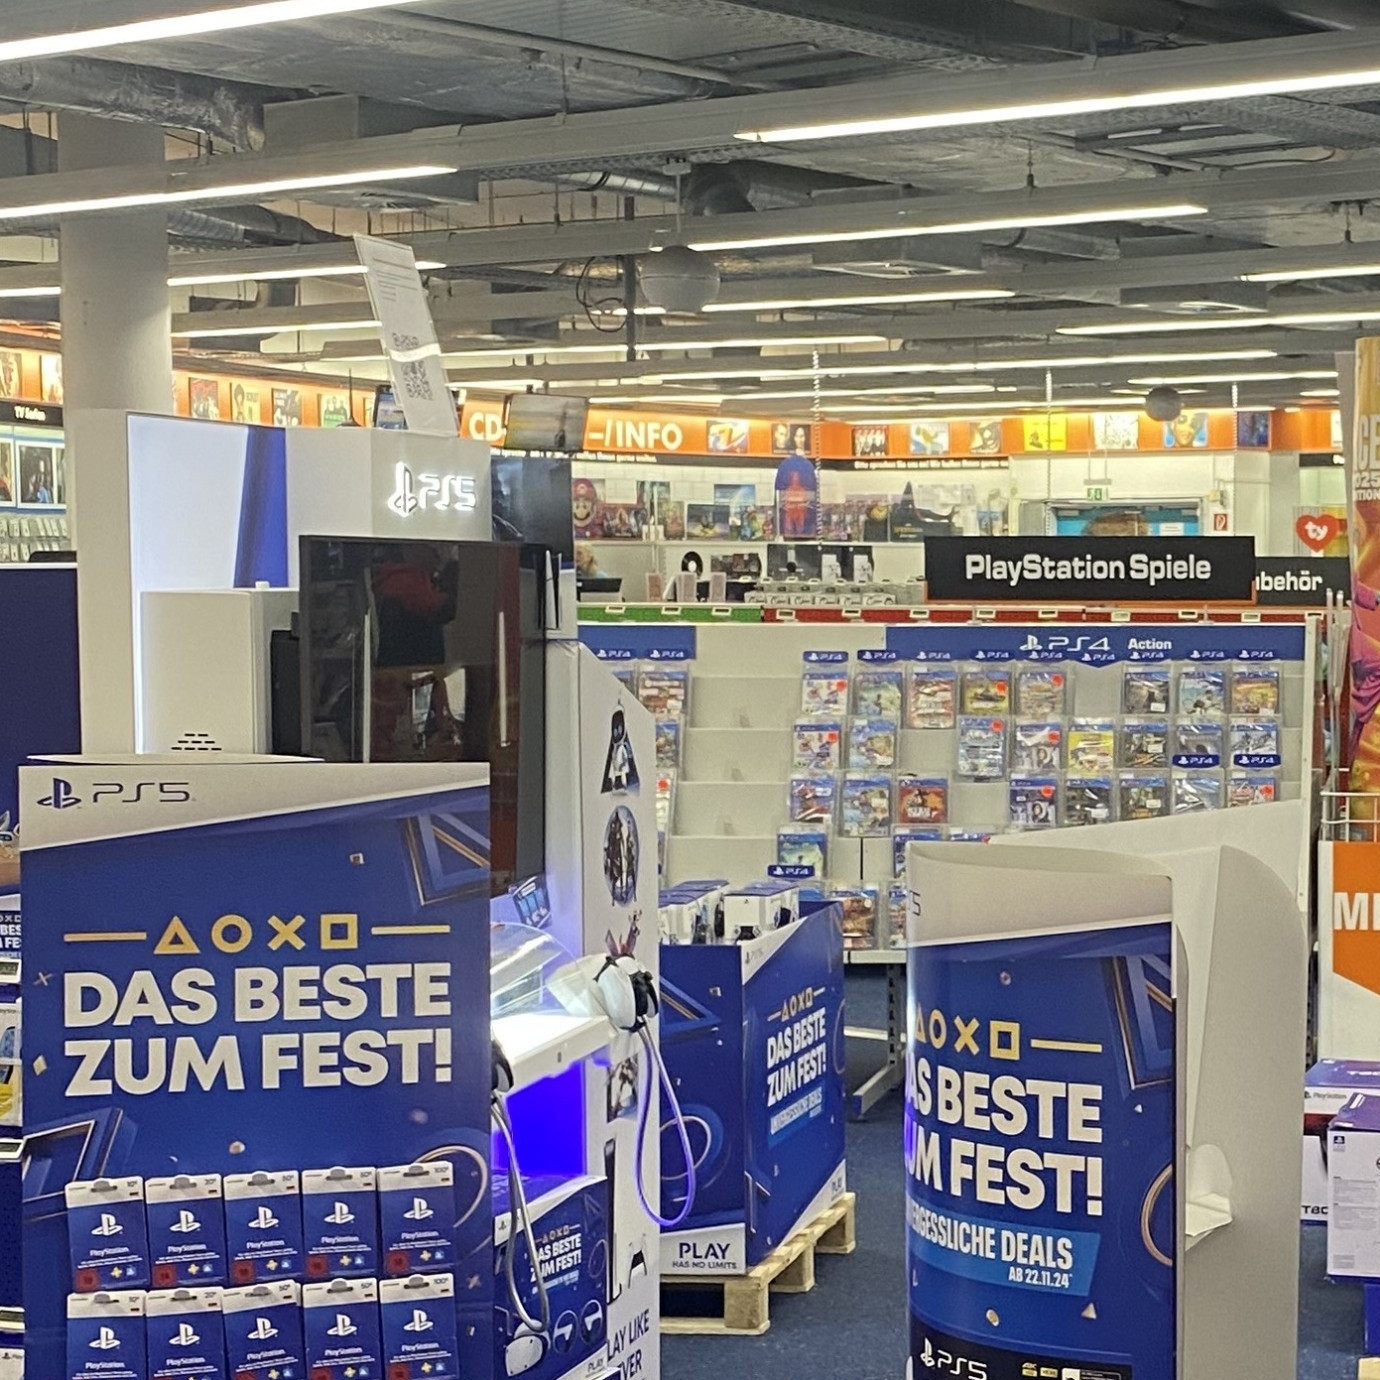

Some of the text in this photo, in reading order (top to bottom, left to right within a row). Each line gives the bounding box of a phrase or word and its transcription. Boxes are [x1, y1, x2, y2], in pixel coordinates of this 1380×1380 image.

[417, 473, 477, 512] PS5
[965, 552, 1212, 587] PlayStation Spiele
[1256, 570, 1324, 593] behör
[1048, 636, 1173, 652] PS4 Action
[92, 781, 191, 803] PS5
[0, 924, 22, 936] BES
[64, 961, 452, 1028] DAS BESTE
[767, 1006, 827, 1070] DAS BESTE
[64, 1027, 453, 1097] ZUM FEST!
[767, 1041, 827, 1108] ZUM FEST!
[904, 1052, 933, 1116] AS
[937, 1063, 1103, 1144] BESTE
[904, 1112, 1103, 1217] UM FEST!
[671, 1260, 690, 1269] HAS
[707, 1260, 737, 1270] LIMITS
[678, 1241, 731, 1260] PLAY
[1001, 1229, 1074, 1271] DEALS
[1008, 1266, 1024, 1283] AB
[607, 1308, 650, 1363] LAY LIKE
